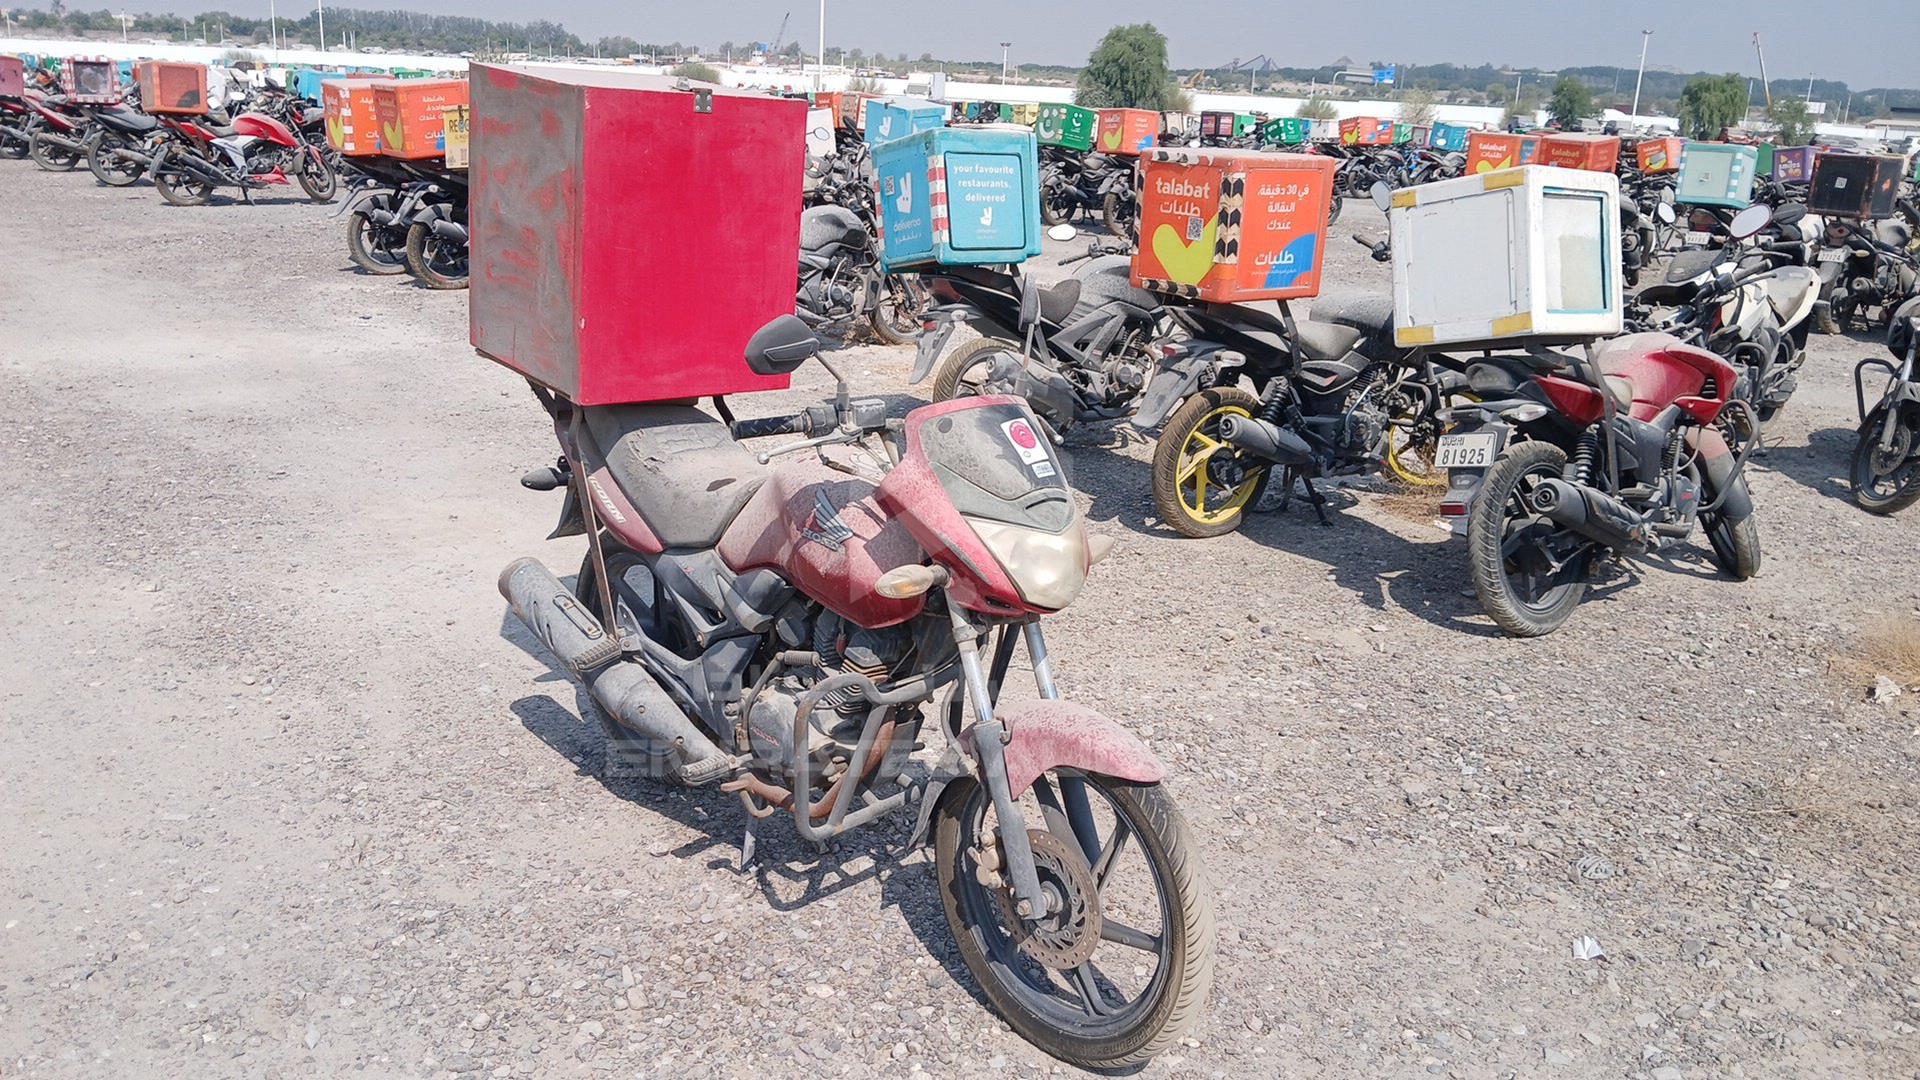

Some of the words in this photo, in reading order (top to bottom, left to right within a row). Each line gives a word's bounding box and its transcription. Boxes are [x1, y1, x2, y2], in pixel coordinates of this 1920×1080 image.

[1478, 142, 1507, 152] talabat
[1551, 147, 1580, 158] talabat
[953, 165, 974, 175] your
[975, 163, 1015, 175] favourite
[1155, 176, 1211, 200] talabat
[1286, 184, 1298, 196] 30
[1298, 183, 1310, 201] في
[965, 192, 1006, 203] delivered
[1160, 199, 1201, 220] طلبات
[1254, 250, 1295, 269] طلبات
[1442, 448, 1486, 465] 81925
